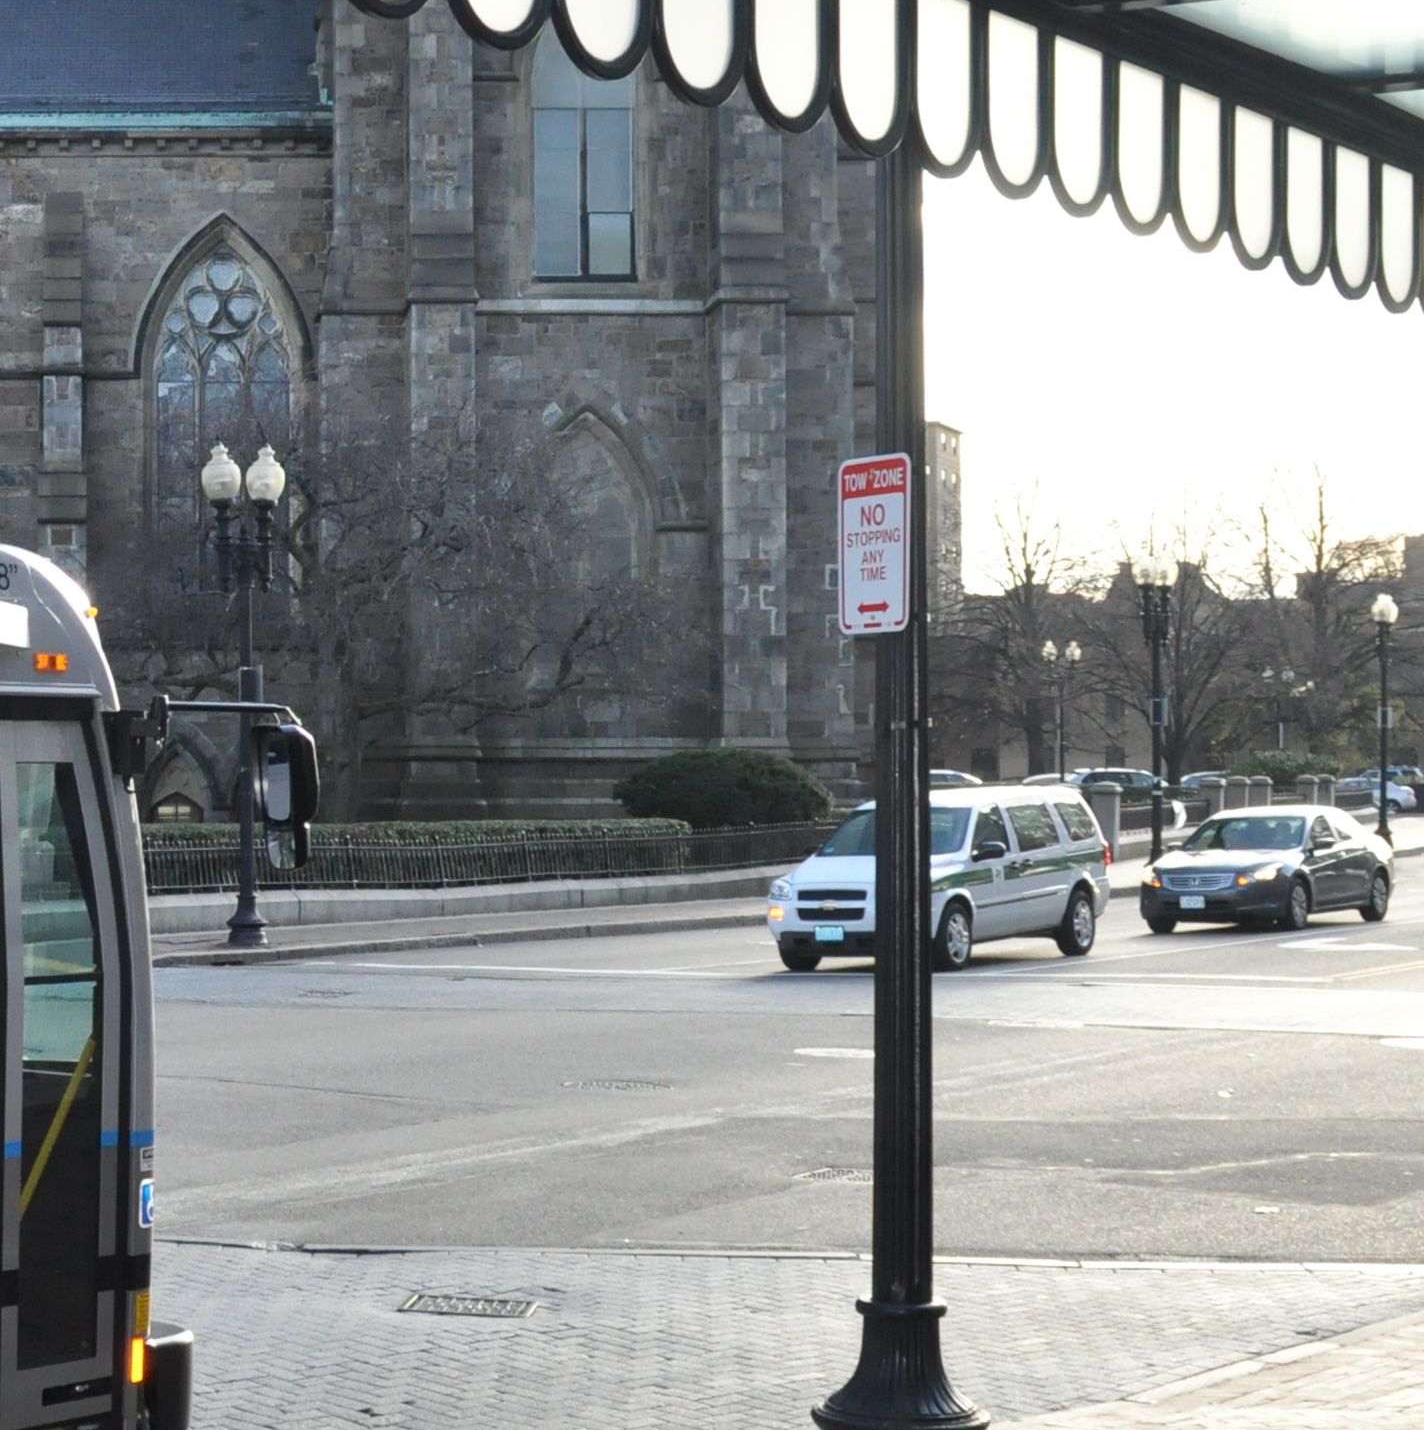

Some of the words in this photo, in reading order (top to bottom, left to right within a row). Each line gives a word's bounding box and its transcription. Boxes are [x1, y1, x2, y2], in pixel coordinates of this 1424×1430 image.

[843, 474, 867, 492] TOW
[872, 467, 904, 488] ZONE
[860, 503, 886, 527] NO
[846, 528, 901, 548] STOPPING
[861, 549, 885, 565] ANY
[859, 565, 887, 582] TIME
